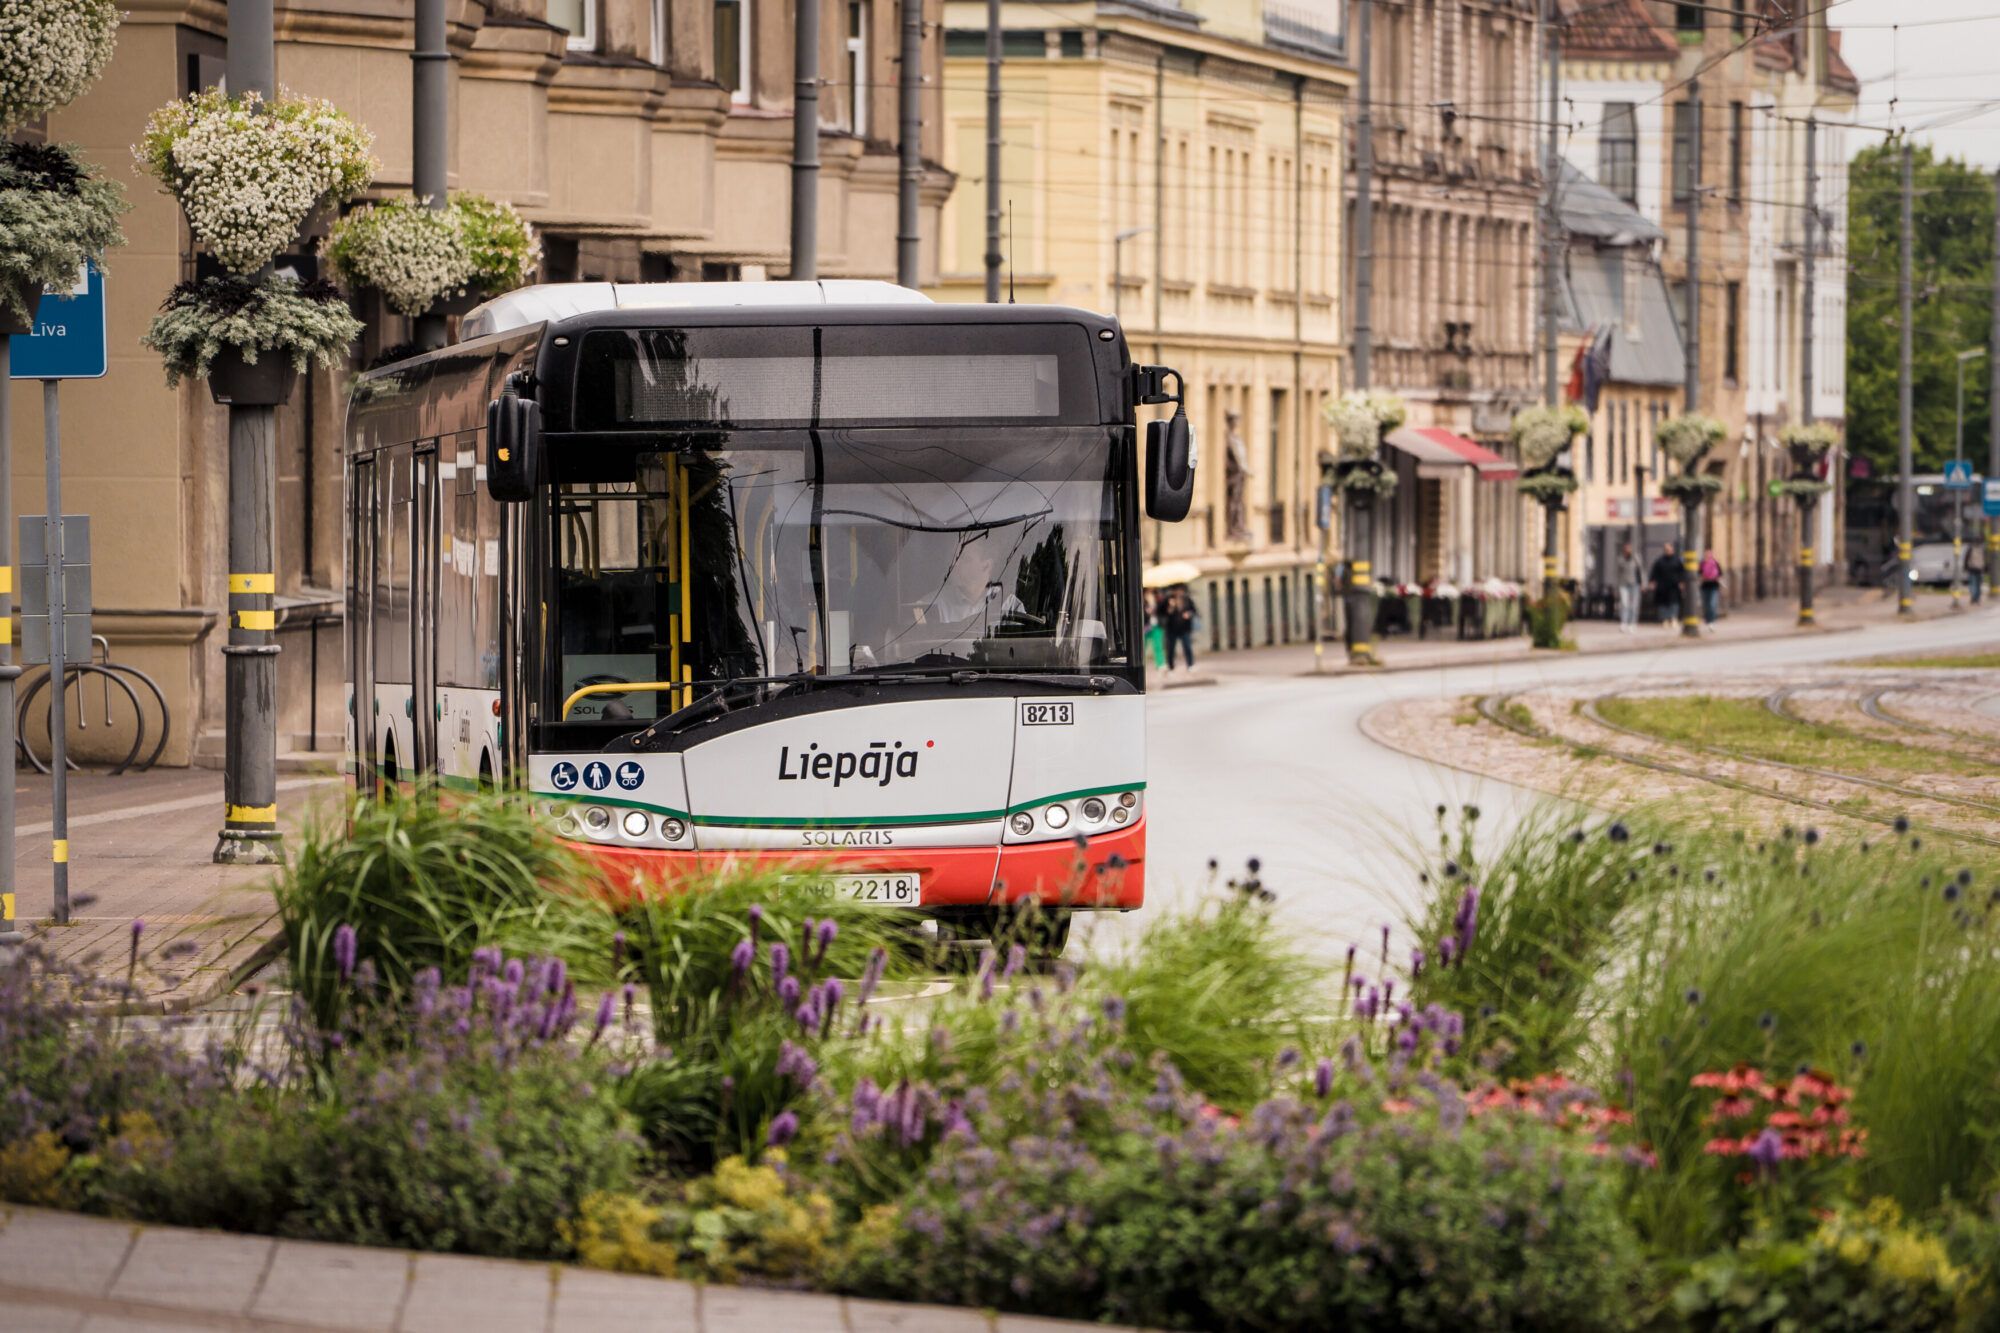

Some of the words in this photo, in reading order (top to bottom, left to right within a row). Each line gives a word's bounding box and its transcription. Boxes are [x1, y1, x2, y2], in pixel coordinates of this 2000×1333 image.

[573, 704, 634, 715] SOLS
[1027, 705, 1069, 722] 8213
[779, 741, 918, 787] Liepāja
[802, 831, 893, 845] SOLARIS
